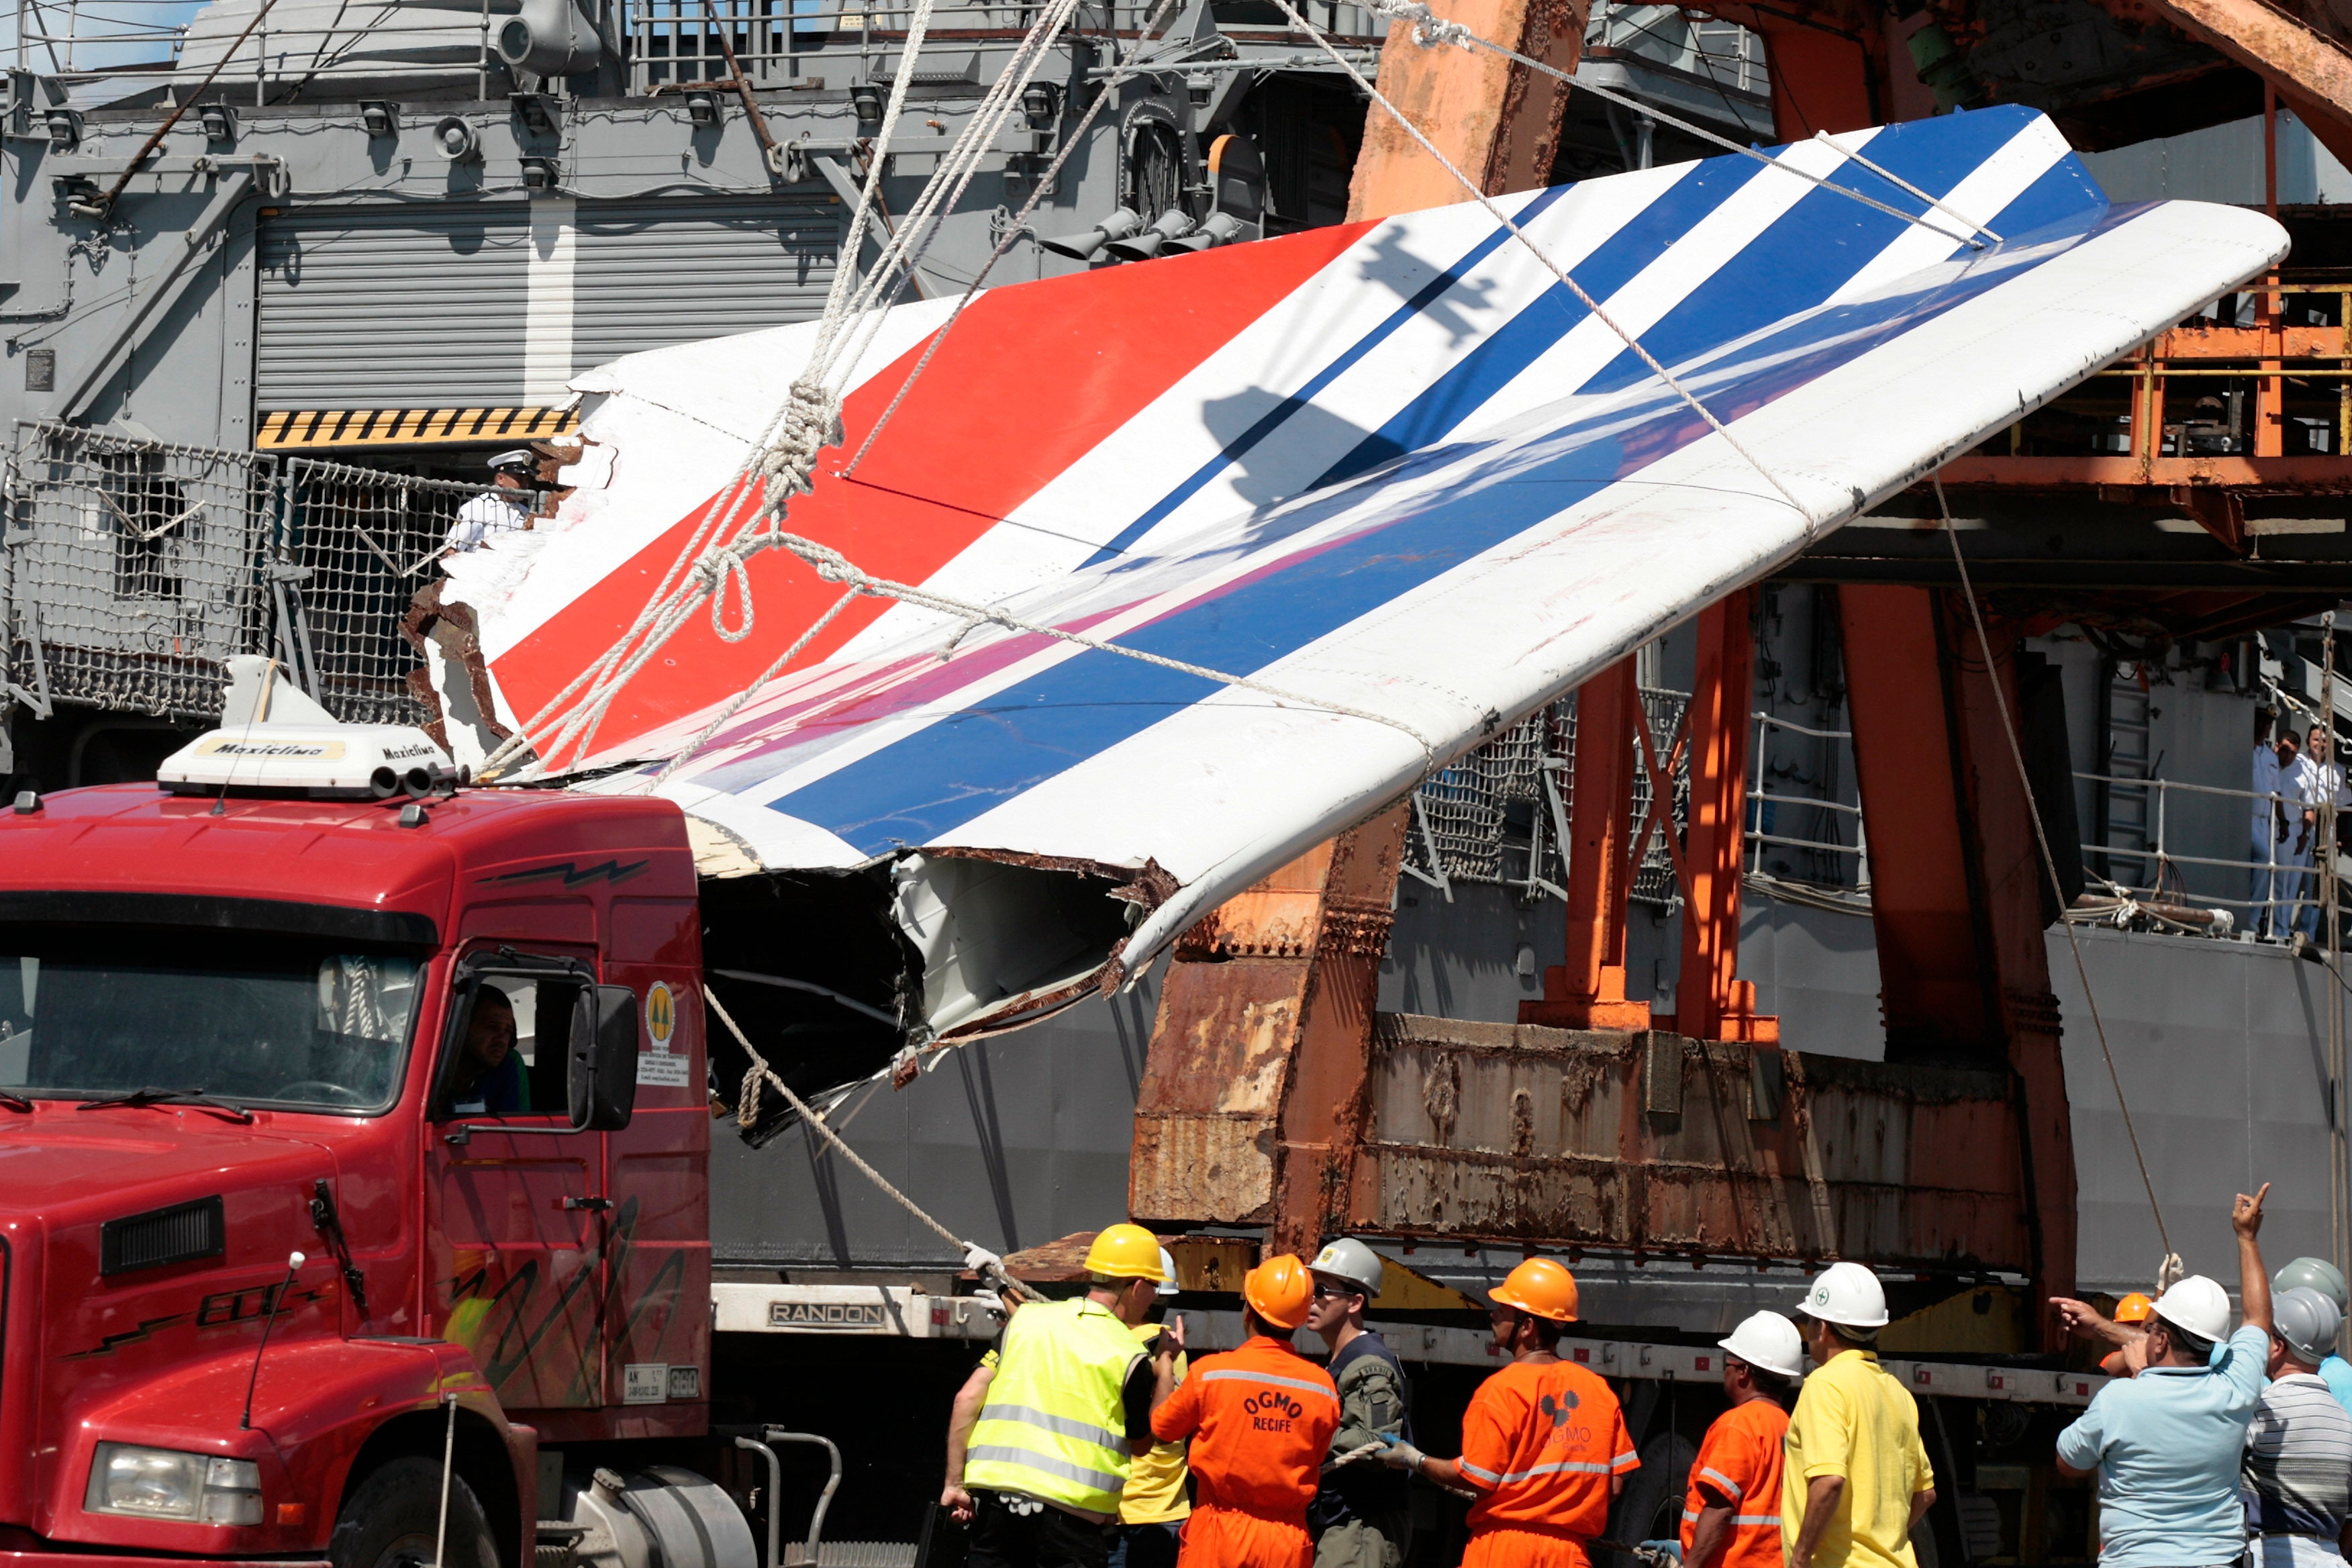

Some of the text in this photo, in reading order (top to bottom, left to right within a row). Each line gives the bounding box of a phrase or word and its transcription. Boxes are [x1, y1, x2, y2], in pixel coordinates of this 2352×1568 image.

[213, 743, 324, 756] Maxiclima
[382, 743, 436, 760] Maxiclima
[773, 1304, 881, 1323] RANDON
[671, 1369, 698, 1395] 360
[1244, 1390, 1303, 1419] OGMO
[1252, 1416, 1291, 1433] RECIFE
